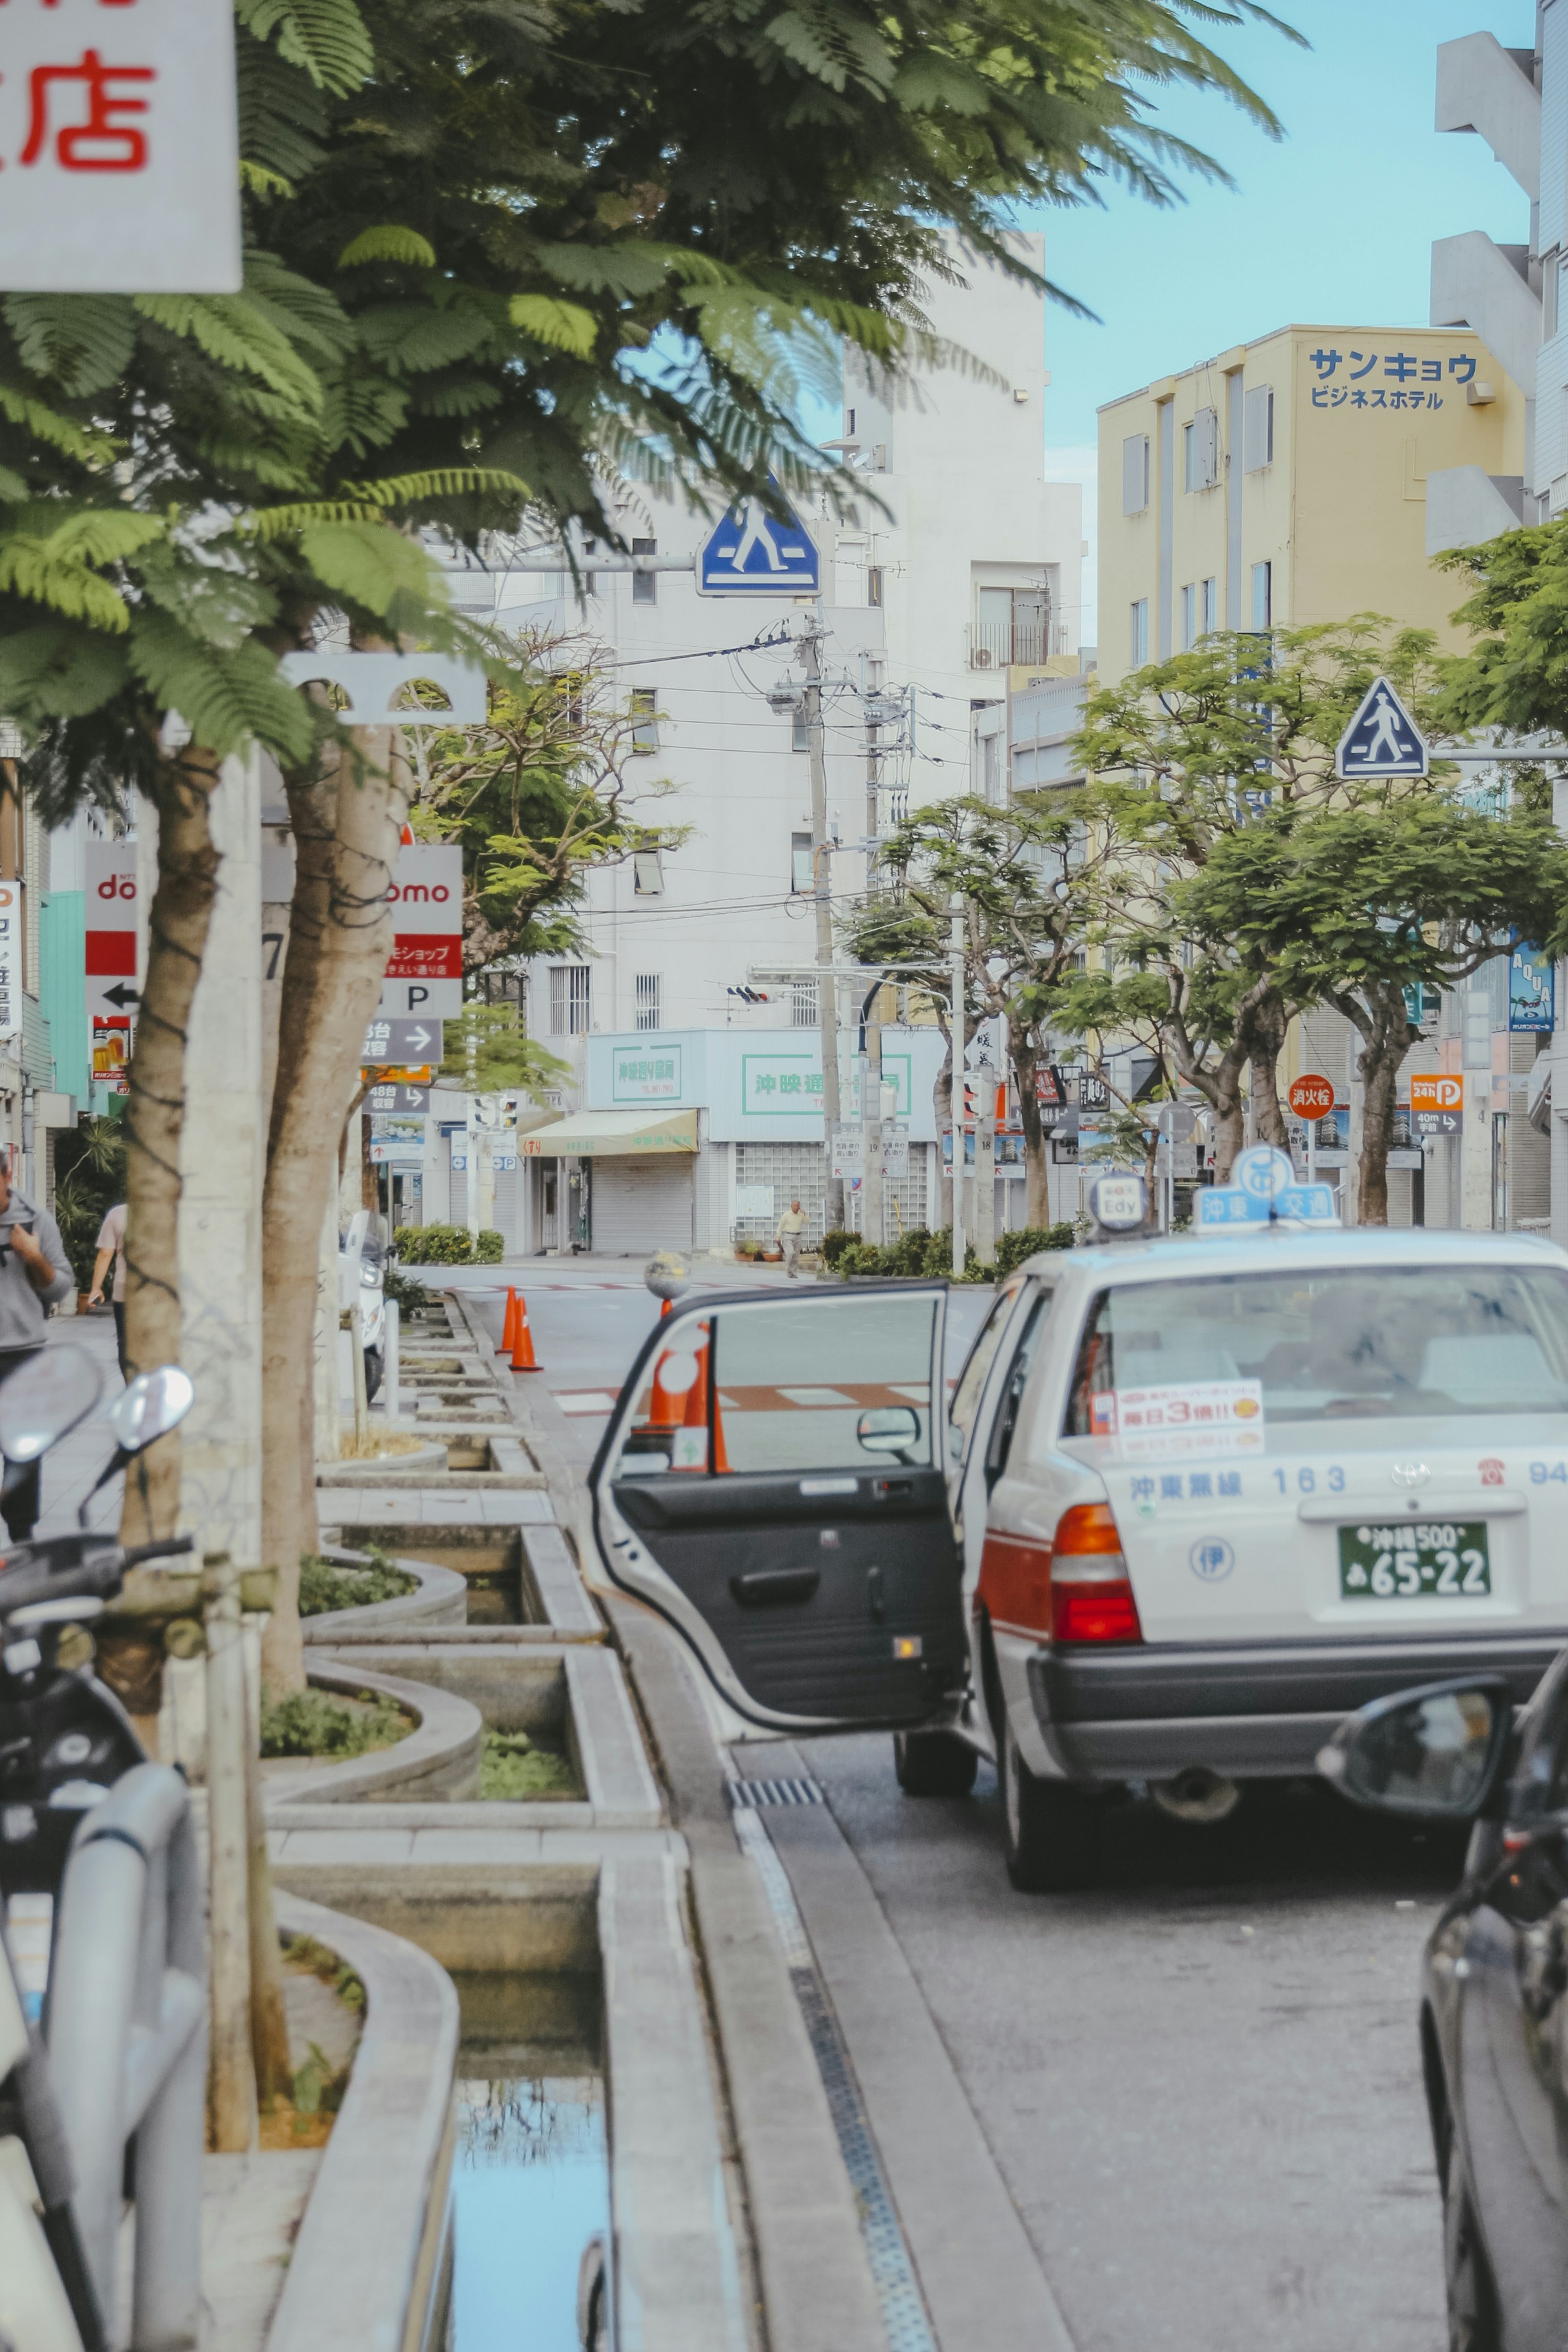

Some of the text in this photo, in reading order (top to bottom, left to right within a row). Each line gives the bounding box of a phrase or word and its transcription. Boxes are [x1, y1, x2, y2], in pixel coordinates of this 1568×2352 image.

[0, 49, 158, 173] 店
[1309, 349, 1477, 385] サンキョウ
[1311, 385, 1444, 410] ビジネスホテル
[386, 965, 447, 976] きえい通り店
[1512, 953, 1551, 1002] AQUA
[408, 986, 430, 1011] P
[370, 1086, 397, 1097] 48台
[1293, 1089, 1330, 1105] 消火栓
[1413, 1087, 1436, 1098] 24h
[373, 1098, 395, 1109] 収容
[1417, 1113, 1439, 1123] 40m
[1419, 1123, 1437, 1132] 手前
[523, 1140, 541, 1155] くすり
[869, 1143, 878, 1152] 19
[982, 1140, 991, 1151] 18
[1104, 1200, 1136, 1215] Edy
[1371, 1548, 1485, 1596] 65-22
